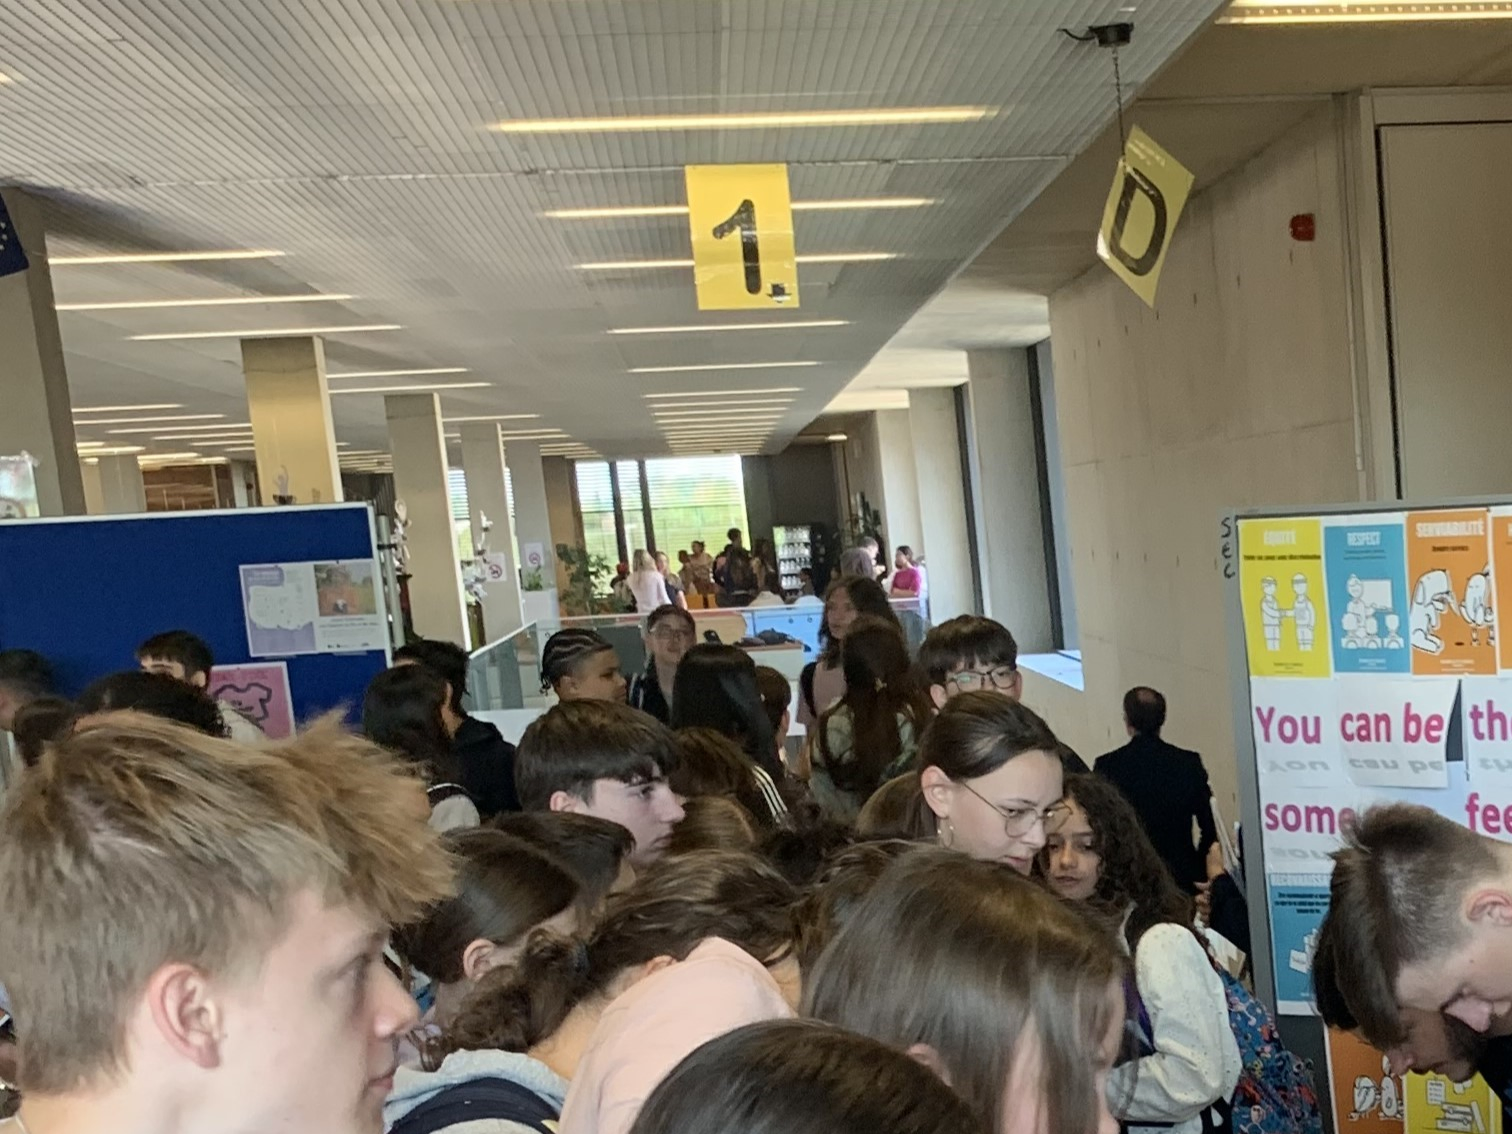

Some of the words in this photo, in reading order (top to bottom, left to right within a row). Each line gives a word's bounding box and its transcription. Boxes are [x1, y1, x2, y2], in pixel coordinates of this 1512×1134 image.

[712, 199, 761, 294] 1
[1109, 166, 1167, 276] D
[1256, 706, 1321, 744] You
[1340, 712, 1391, 743] can
[1403, 702, 1445, 744] be
